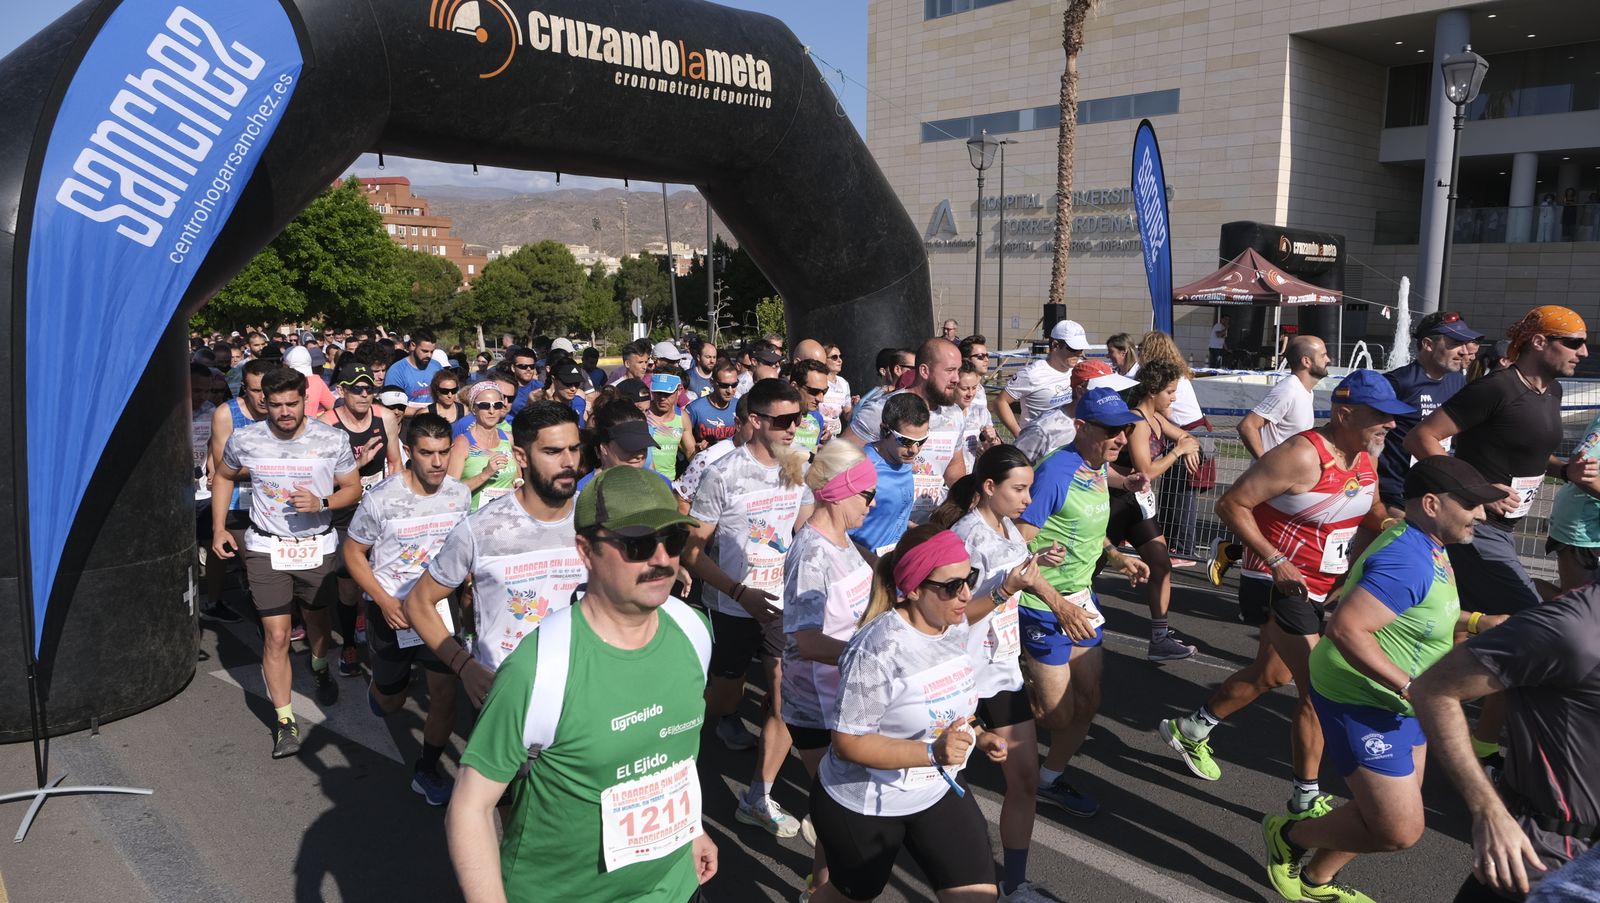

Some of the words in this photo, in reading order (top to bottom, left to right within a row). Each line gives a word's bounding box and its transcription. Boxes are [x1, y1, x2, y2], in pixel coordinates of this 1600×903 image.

[614, 71, 711, 101] cronometraje
[712, 86, 772, 110] deportivo
[169, 73, 294, 265] centrohogarsanchez.es
[978, 193, 1044, 212] HOSPITAL
[1100, 238, 1144, 252] INFANTI
[277, 546, 319, 560] 1037
[616, 763, 632, 780] El
[633, 752, 669, 775] Ejido
[621, 782, 660, 801] CARRERA
[660, 777, 673, 789] SIN
[618, 789, 691, 838] 1211
